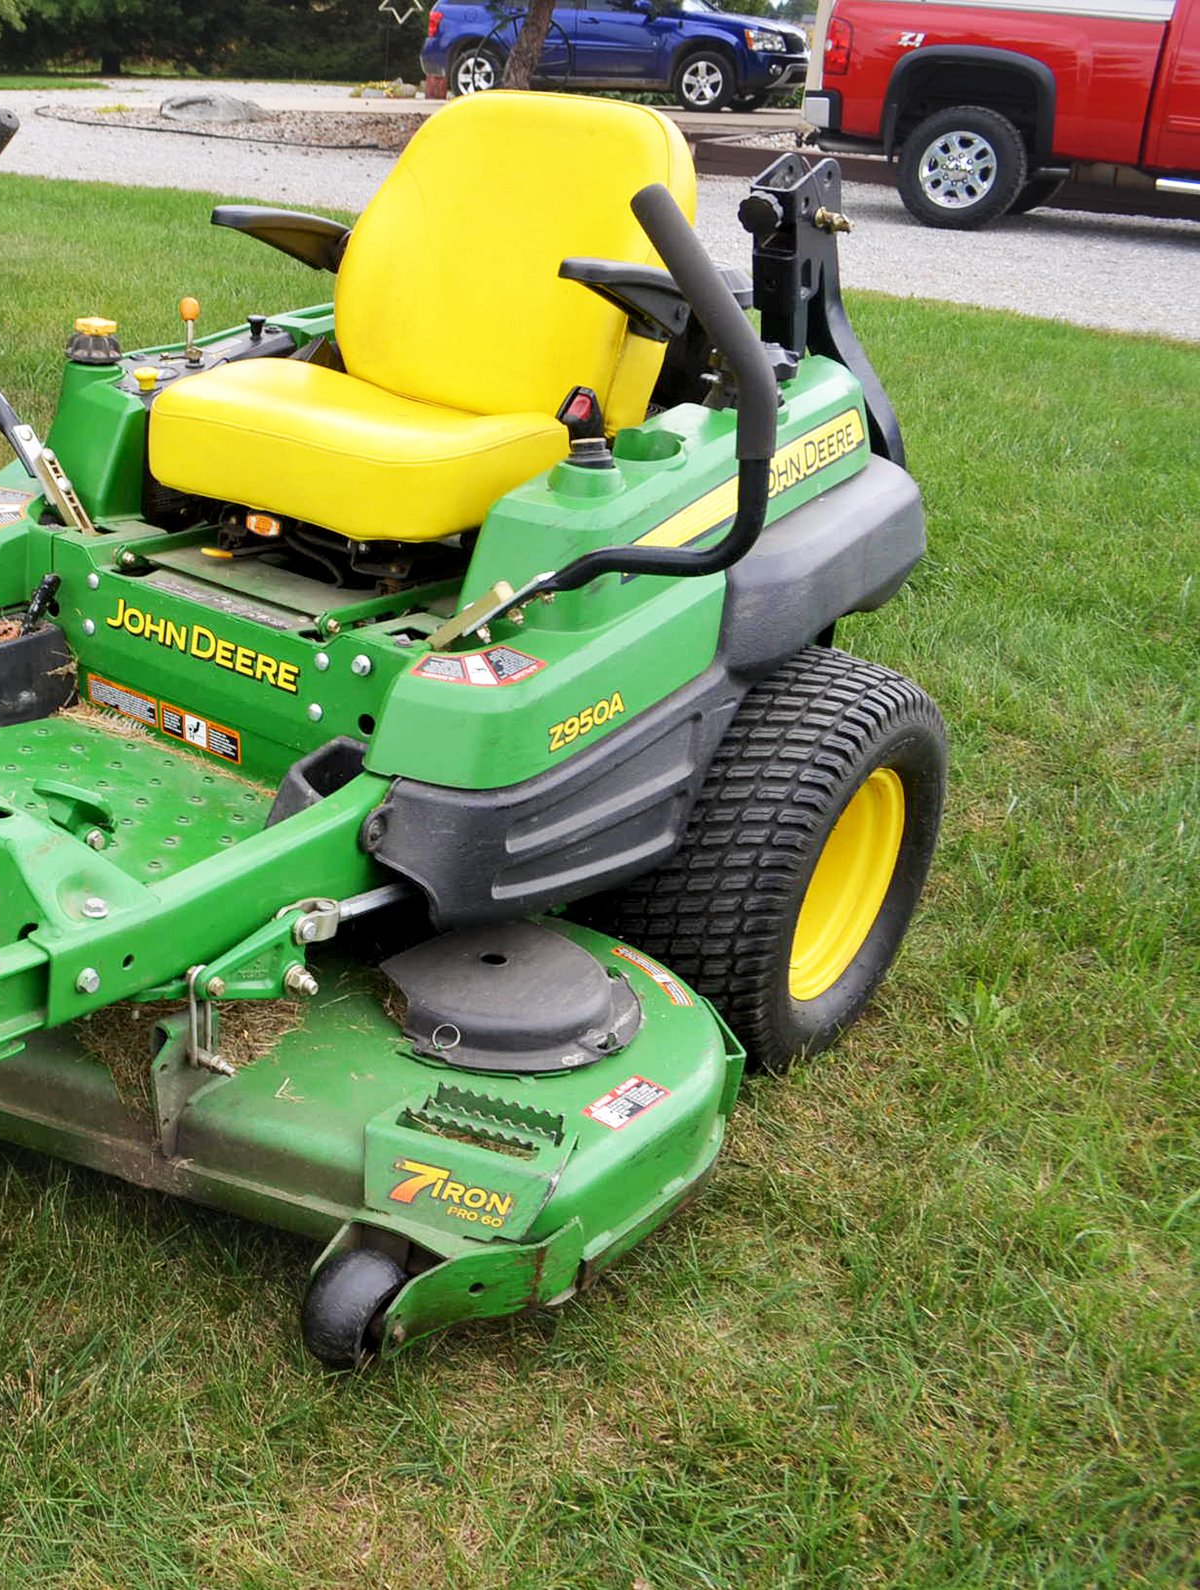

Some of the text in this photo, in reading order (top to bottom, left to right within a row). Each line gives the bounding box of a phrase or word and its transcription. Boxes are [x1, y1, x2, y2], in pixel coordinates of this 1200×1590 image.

[804, 423, 854, 471] DEERE
[106, 598, 299, 693] JOHN DEERE
[548, 691, 625, 752] Z950A
[446, 1206, 505, 1228] PRO 60
